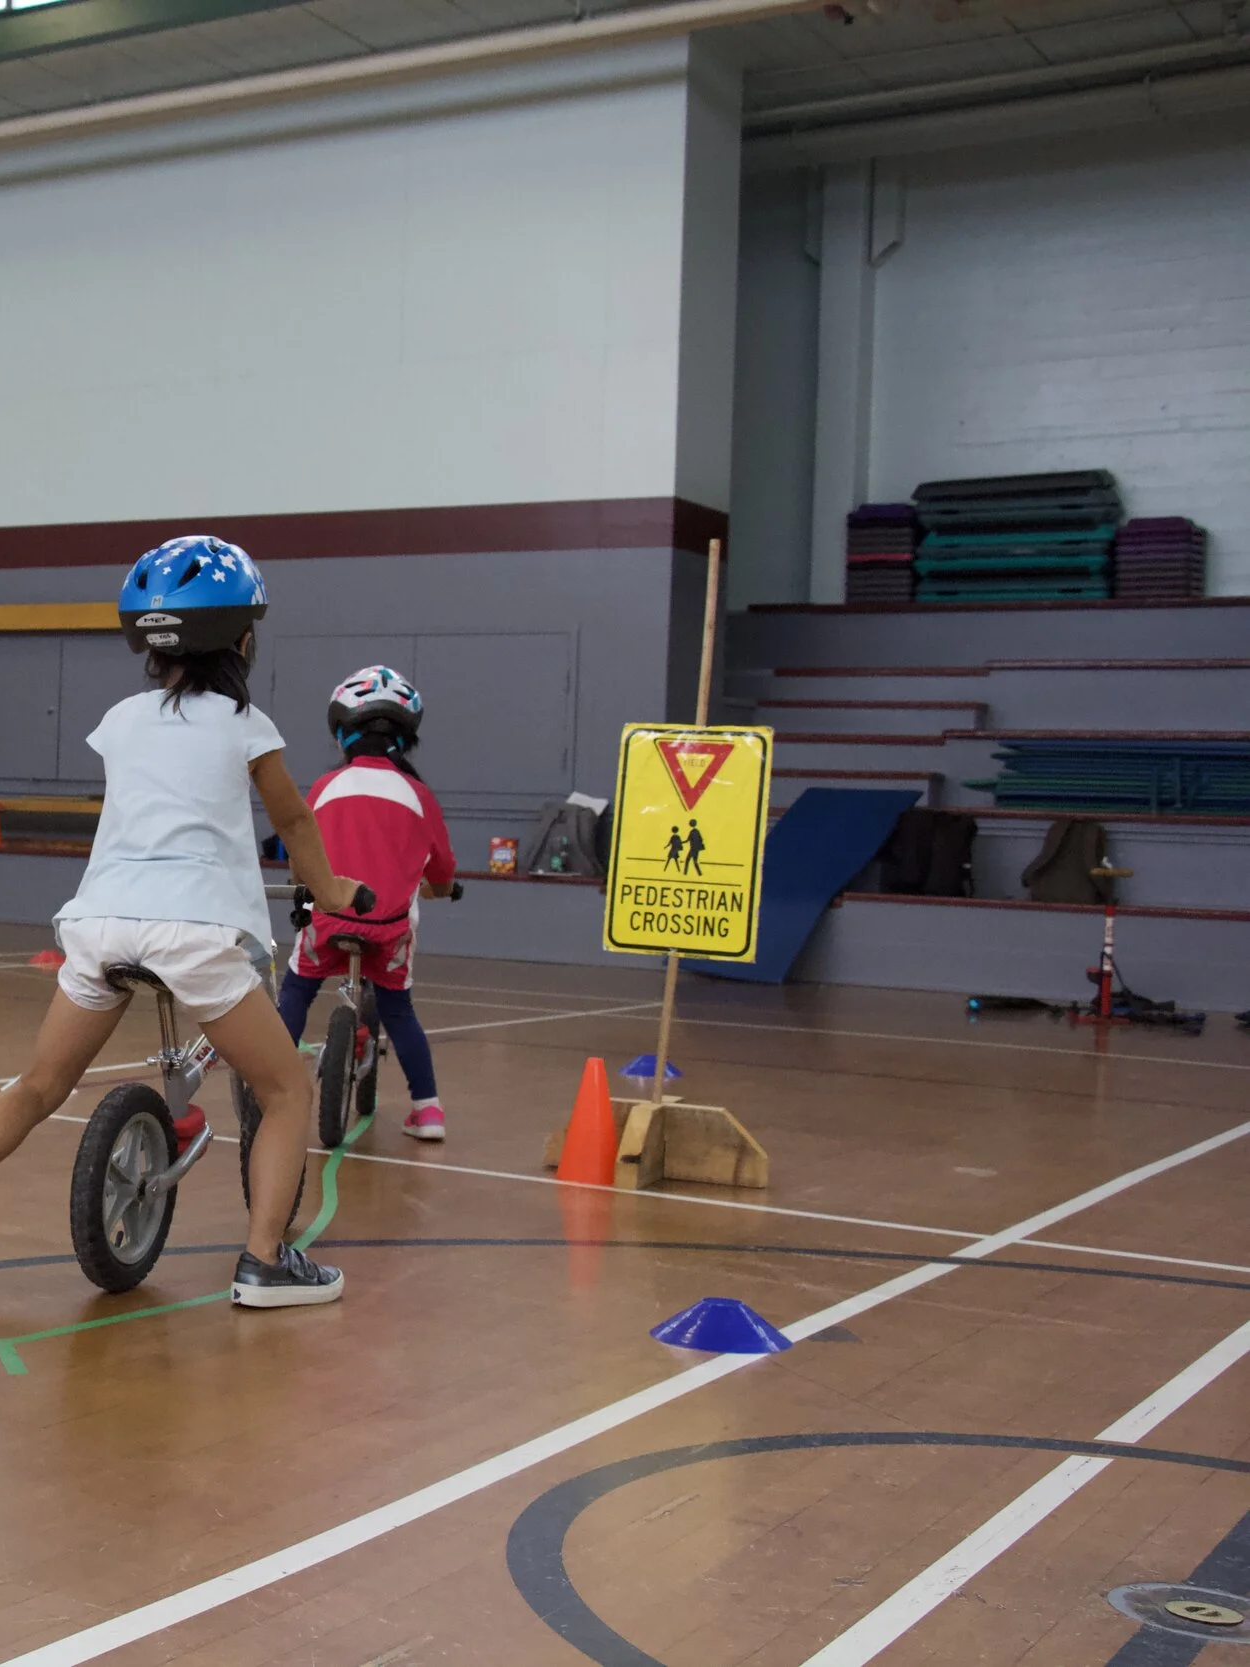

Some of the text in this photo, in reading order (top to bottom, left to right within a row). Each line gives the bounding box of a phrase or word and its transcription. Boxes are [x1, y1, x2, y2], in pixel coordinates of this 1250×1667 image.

[683, 758, 706, 768] YIELD
[620, 883, 744, 914] PEDESTRIAN
[629, 910, 730, 938] CROSSING
